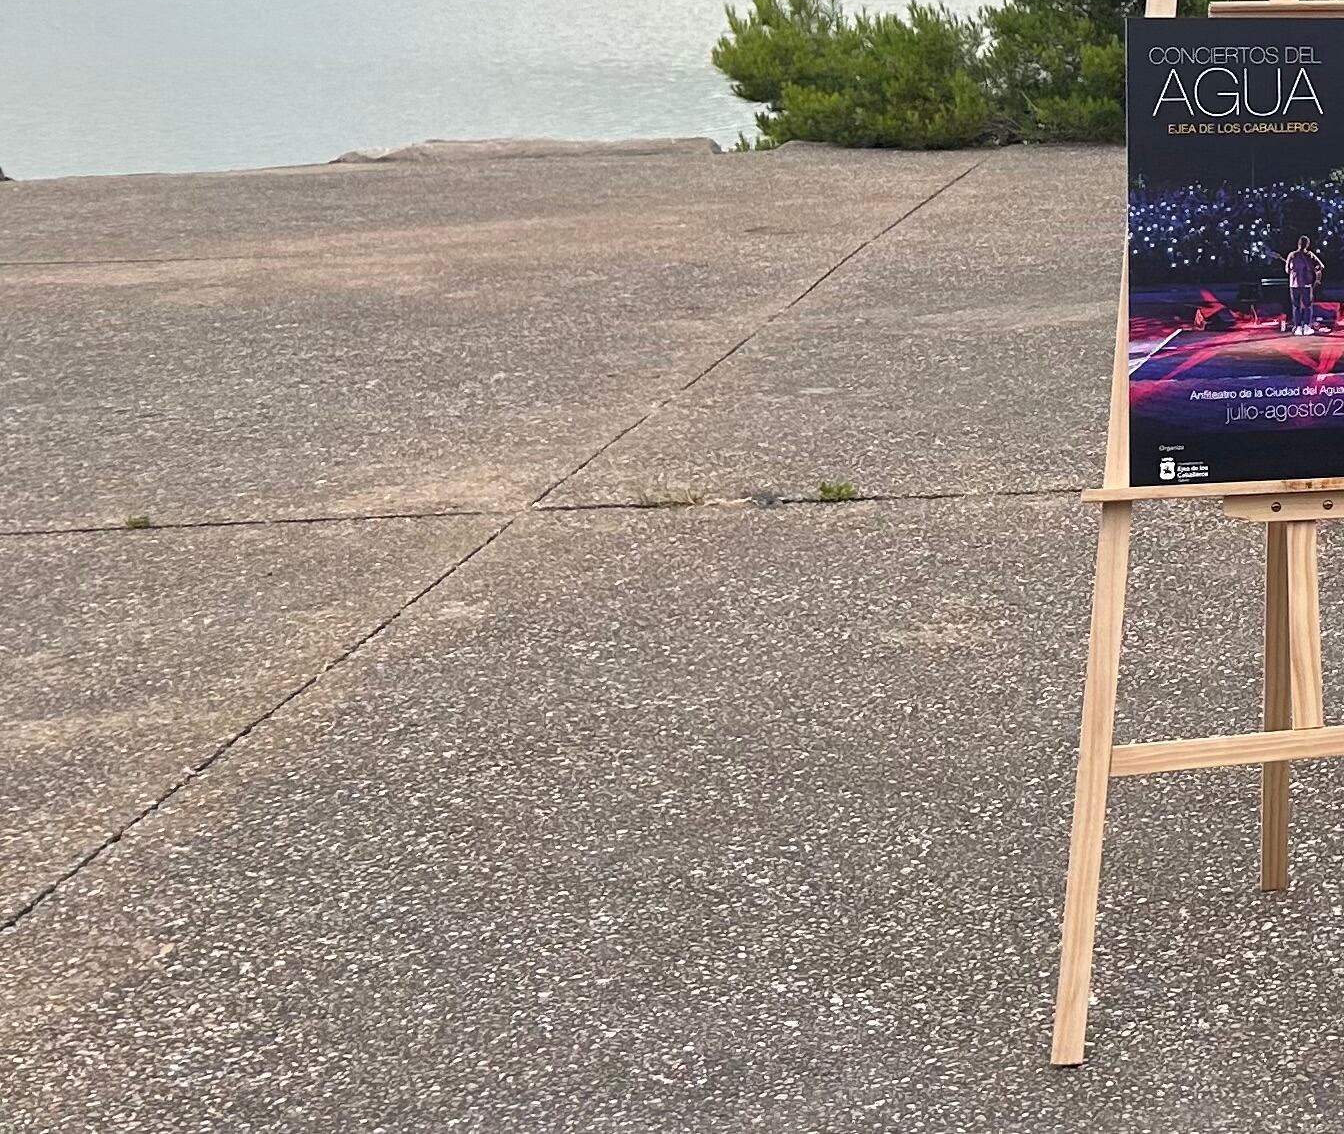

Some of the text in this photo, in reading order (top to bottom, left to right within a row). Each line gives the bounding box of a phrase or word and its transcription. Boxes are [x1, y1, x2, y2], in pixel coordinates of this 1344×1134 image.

[1149, 46, 1322, 65] CONCIERTOS DEL
[1152, 67, 1324, 117] AGUA
[1168, 121, 1319, 134] EJEA DE LOS CABALLEROS
[1239, 389, 1252, 398] de
[1254, 388, 1263, 397] la
[1265, 386, 1300, 397] Ciudad
[1302, 384, 1318, 396] del
[1319, 384, 1344, 397] Agua
